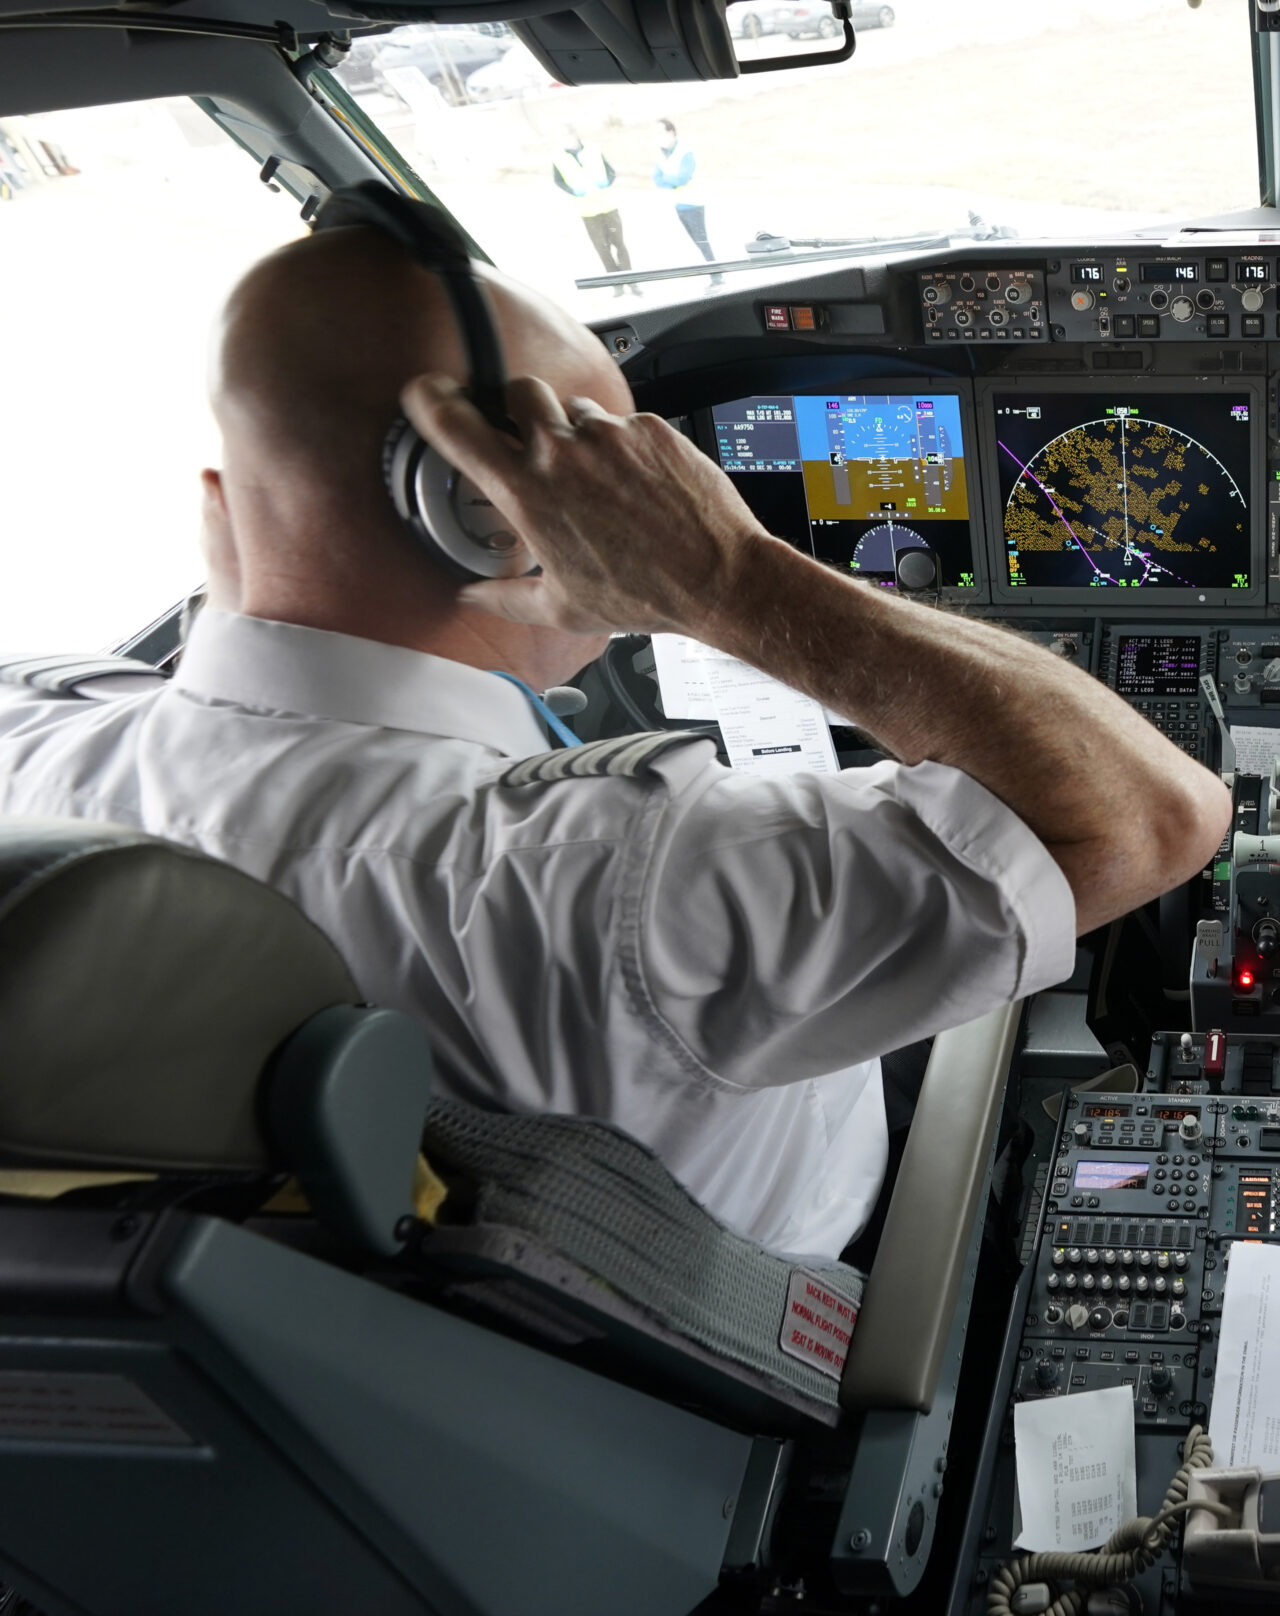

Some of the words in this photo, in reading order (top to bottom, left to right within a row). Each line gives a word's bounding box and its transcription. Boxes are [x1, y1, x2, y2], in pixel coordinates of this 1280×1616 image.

[1081, 268, 1099, 280] 176
[1175, 267, 1194, 279] 146
[1245, 266, 1264, 278] 176
[1260, 839, 1267, 851] 1
[1199, 939, 1220, 947] PULL
[1209, 1034, 1220, 1062] 1
[1219, 1115, 1227, 1137] CARGO
[1202, 1174, 1210, 1192] NAV
[806, 1281, 821, 1301] BACK
[822, 1292, 836, 1310] REST
[836, 1301, 851, 1320] MUST
[791, 1300, 815, 1326] NORMAL
[815, 1314, 834, 1335] FLIGHT
[791, 1329, 807, 1348] SEAT
[807, 1337, 814, 1352] IS
[814, 1342, 835, 1363] MOVING
